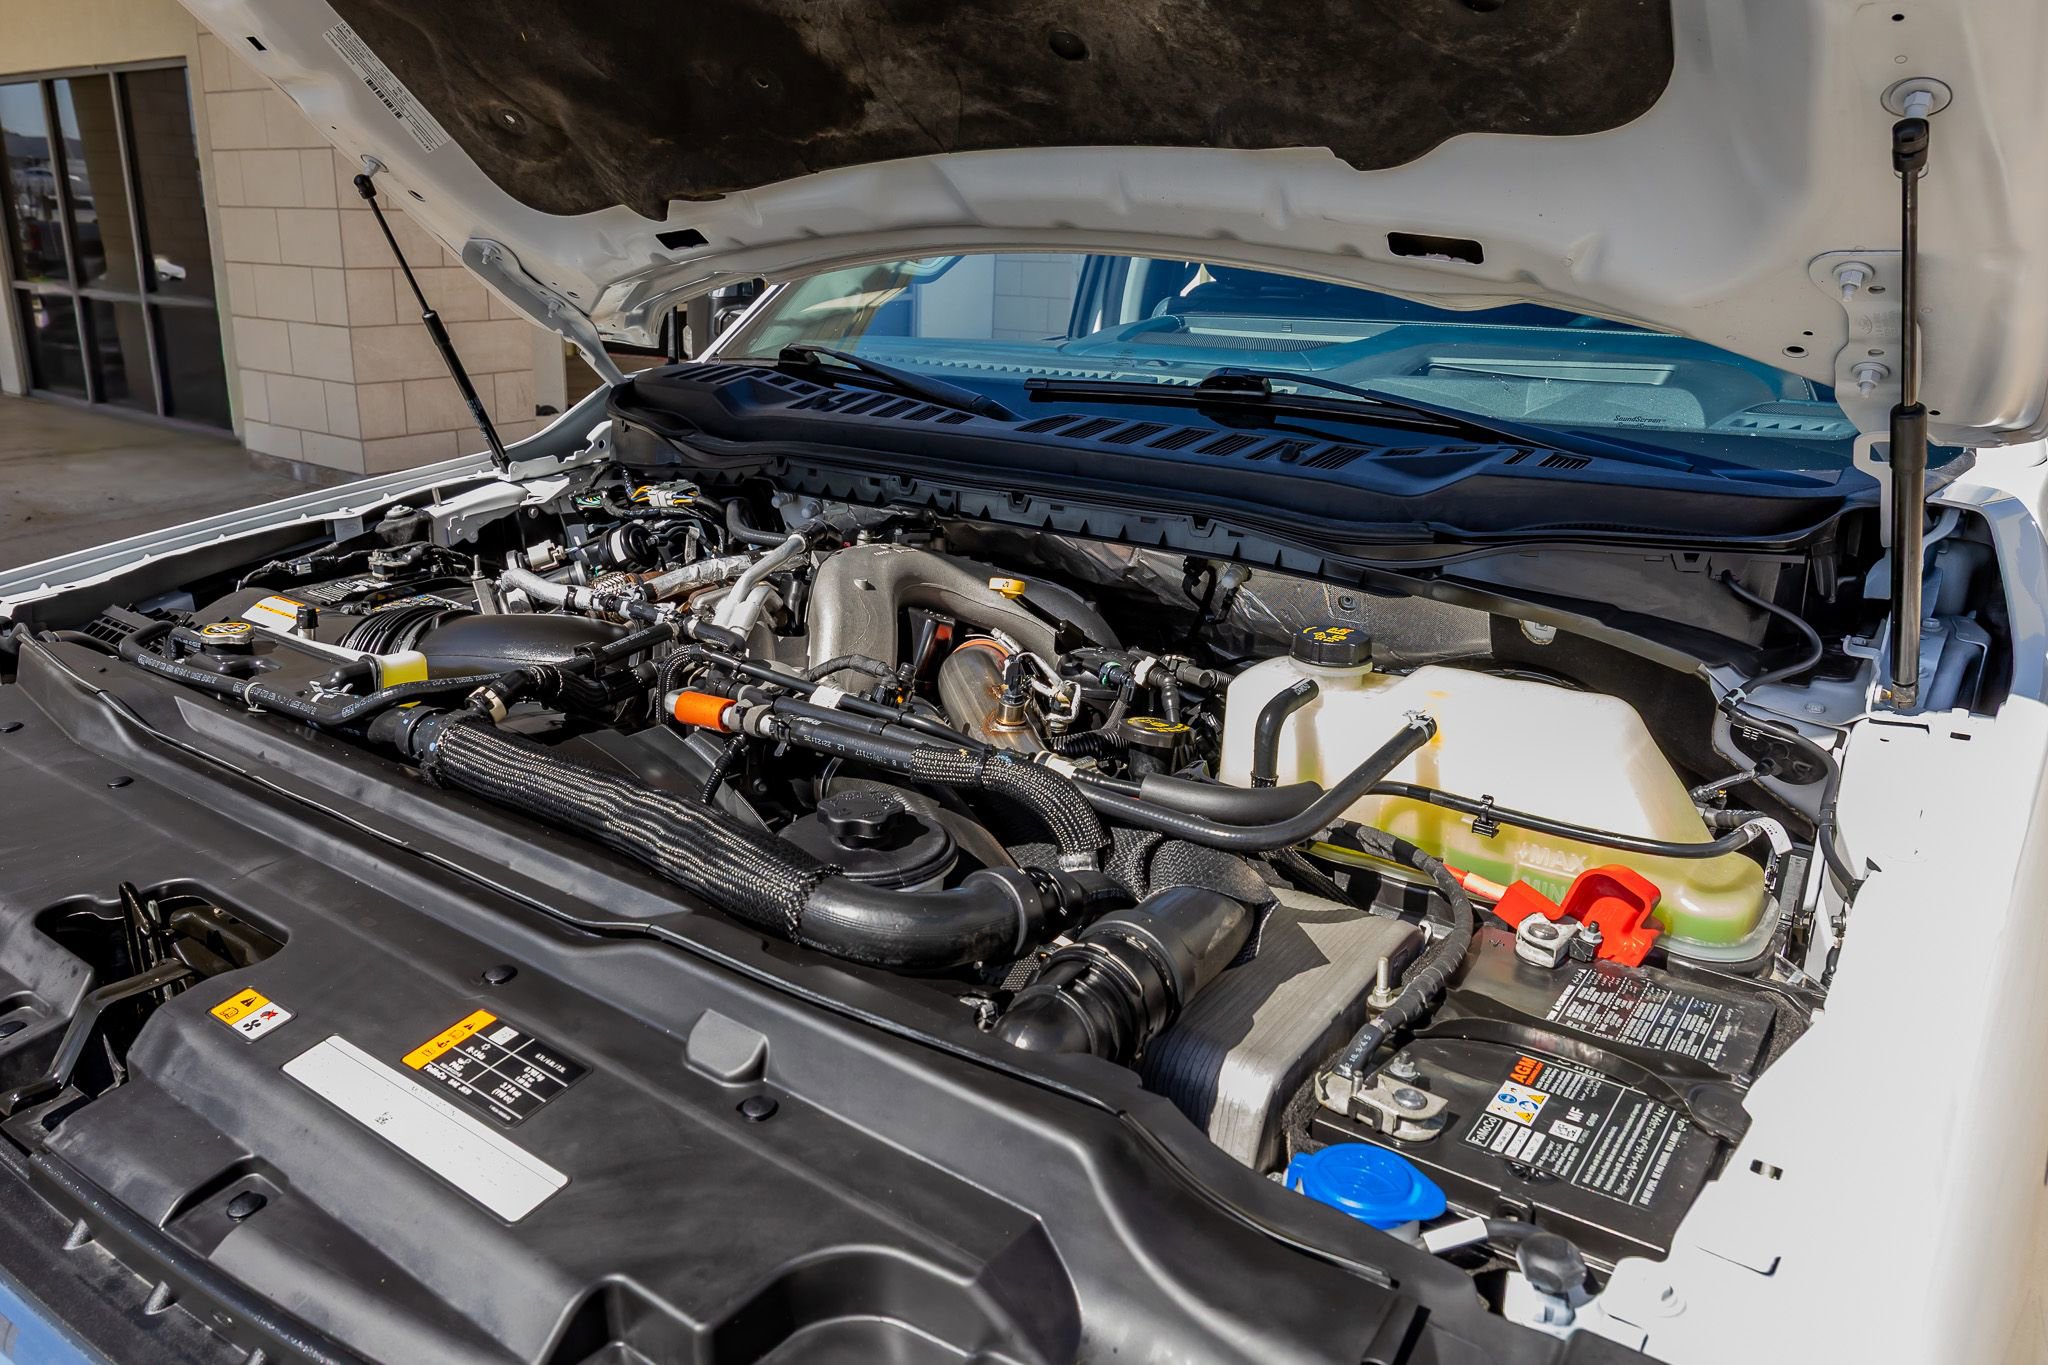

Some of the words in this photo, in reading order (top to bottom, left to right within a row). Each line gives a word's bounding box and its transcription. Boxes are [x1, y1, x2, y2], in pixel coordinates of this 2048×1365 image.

[1614, 415, 1661, 423] SoundScreen
[1529, 844, 1588, 873] MAX
[1510, 1056, 1537, 1084] AGM
[1565, 1106, 1585, 1123] MF
[1472, 1117, 1498, 1145] FoMoCo
